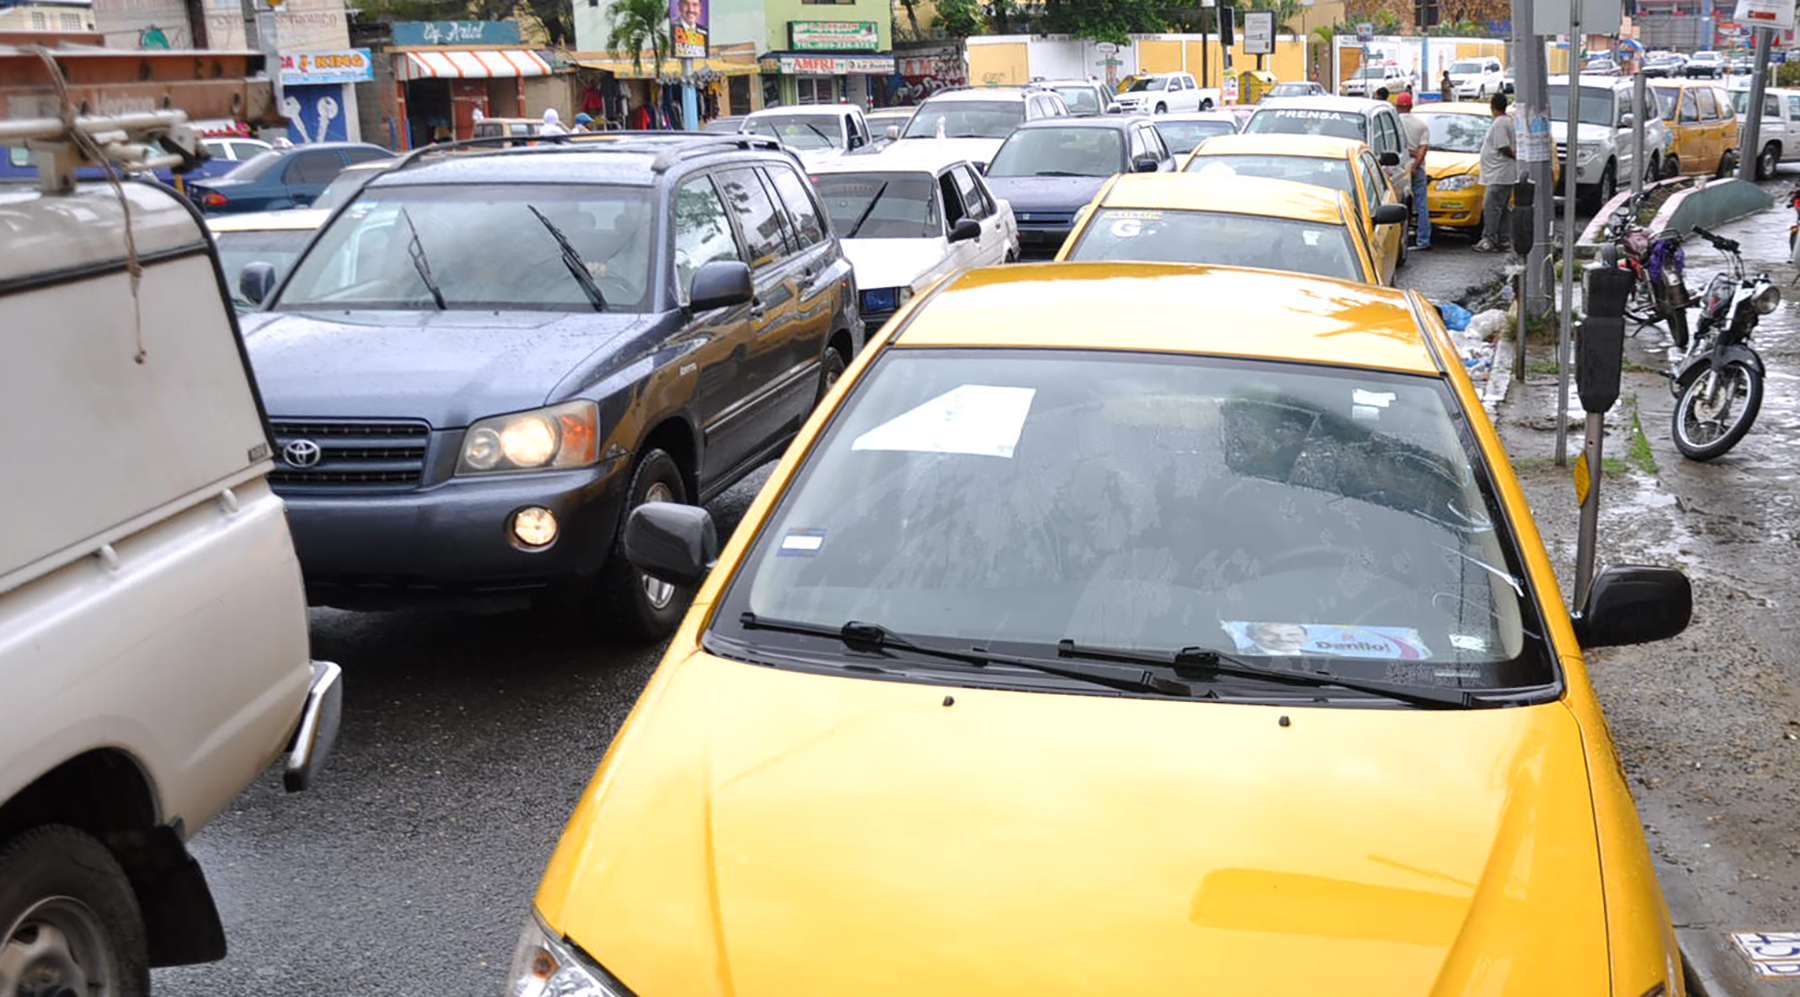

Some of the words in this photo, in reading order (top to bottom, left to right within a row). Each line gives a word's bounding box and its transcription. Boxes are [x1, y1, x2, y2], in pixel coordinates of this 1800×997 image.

[314, 54, 364, 69] KING
[1275, 110, 1342, 120] PRENSA
[1111, 219, 1142, 237] G
[1315, 640, 1392, 653] Danilo!
